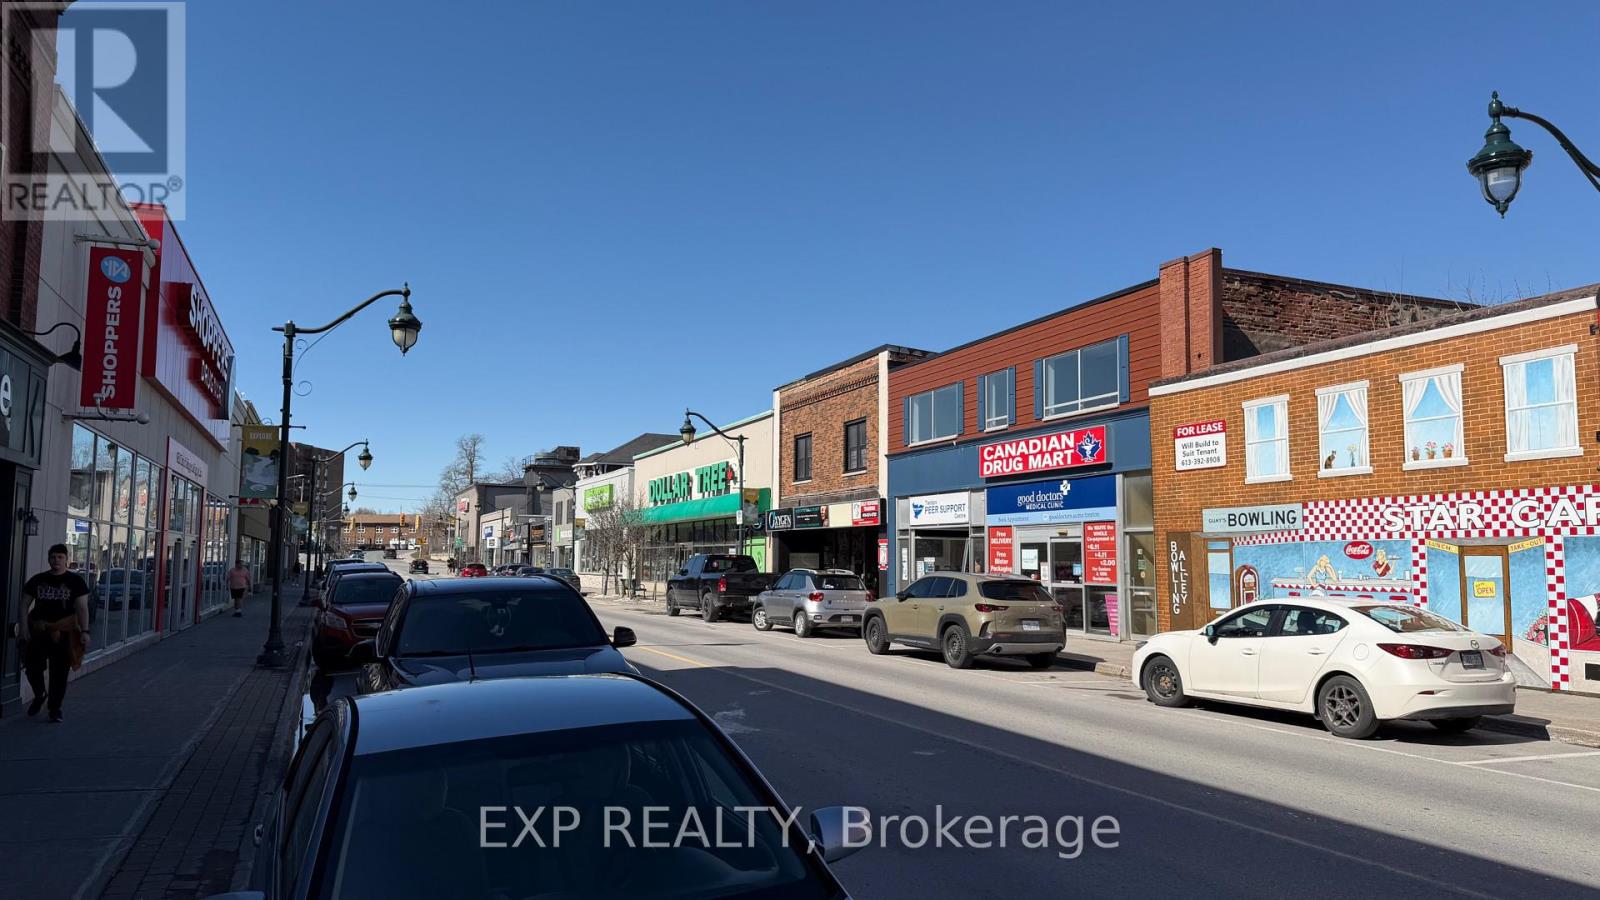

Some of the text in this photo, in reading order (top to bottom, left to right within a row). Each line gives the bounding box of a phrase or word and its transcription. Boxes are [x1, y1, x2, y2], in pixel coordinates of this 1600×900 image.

[101, 286, 122, 399] SHOPPERS
[1177, 422, 1223, 437] FOR LEASE
[983, 433, 1074, 460] CANADIAN
[1195, 440, 1211, 448] Build
[1196, 448, 1217, 456] Tenant
[983, 449, 1074, 475] DRUG MART
[649, 461, 729, 502] DOLLAR TREE
[1017, 490, 1063, 507] good doctors
[1026, 501, 1064, 510] MEDICAL CLINIC
[925, 503, 966, 514] PEER SUPPORT
[1383, 502, 1485, 532] STAR
[1228, 509, 1297, 527] BOWLING
[1428, 541, 1451, 551] LUNCH
[1510, 538, 1543, 551] TAKE-OUT
[1170, 541, 1180, 615] BOWLING
[1179, 550, 1188, 605] ALLEY
[1476, 586, 1494, 595] OPEN
